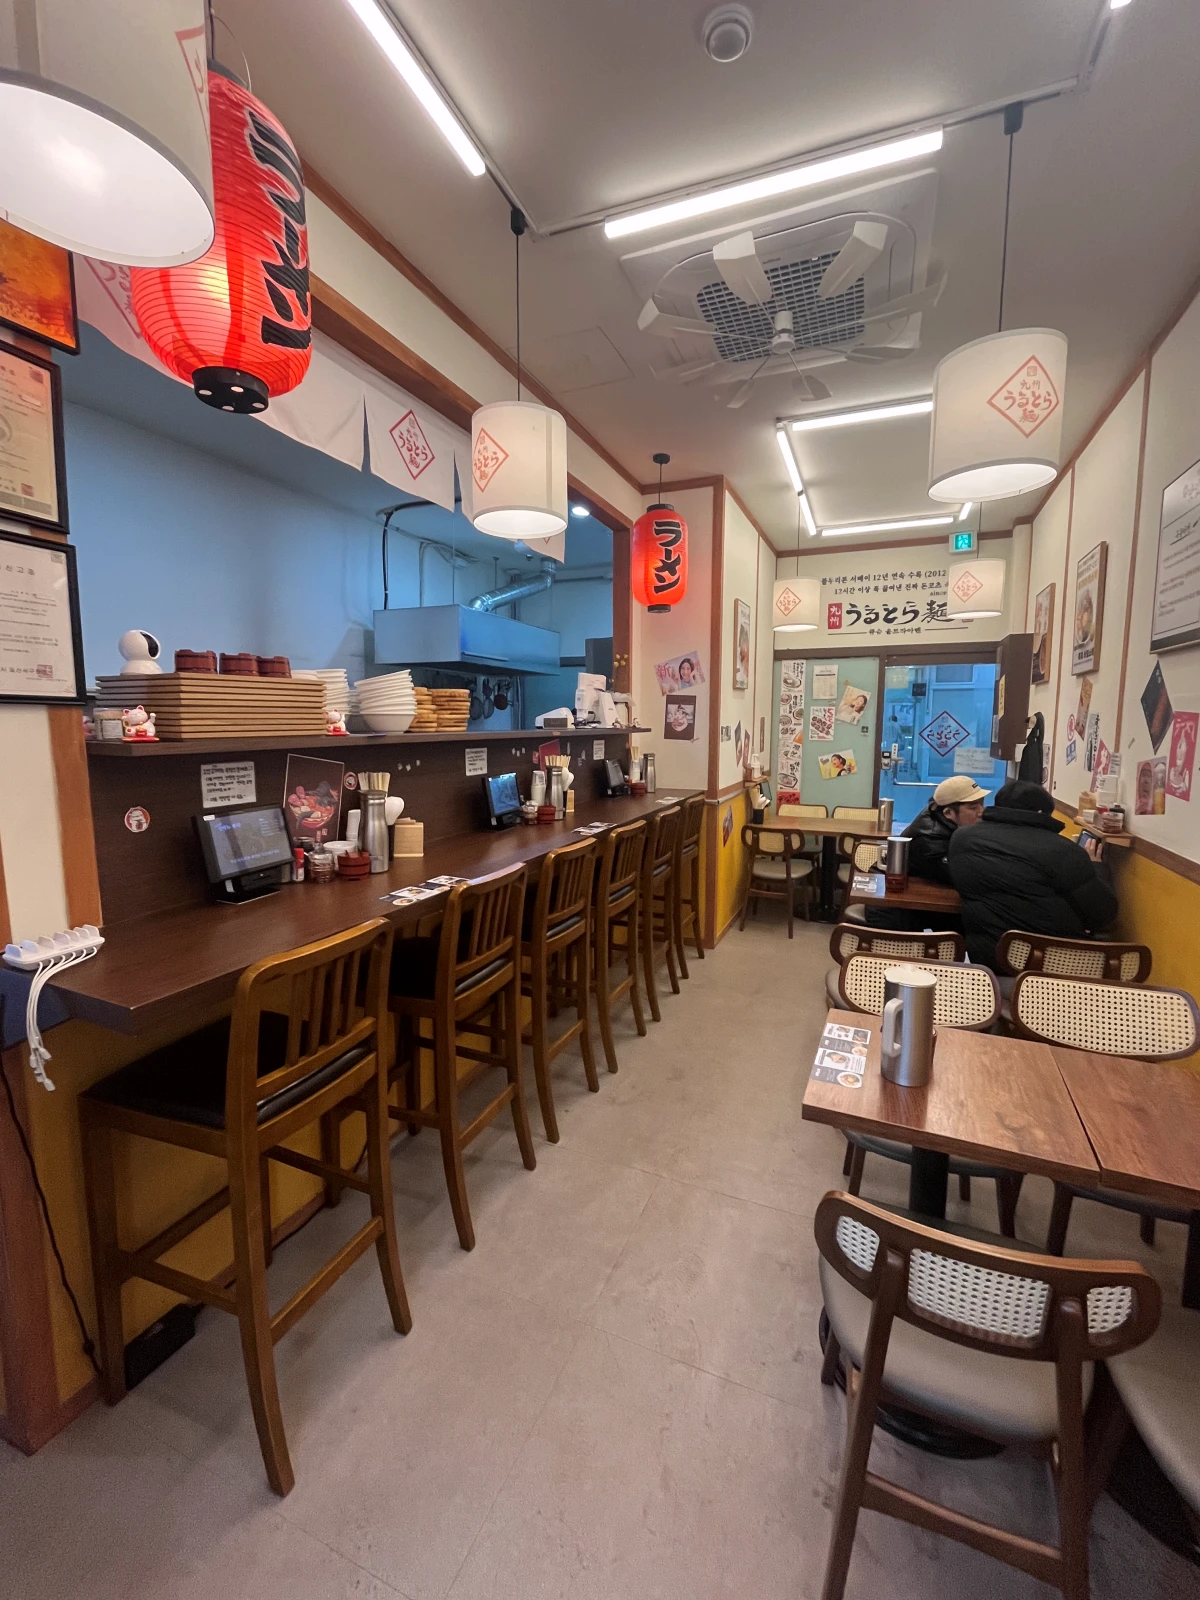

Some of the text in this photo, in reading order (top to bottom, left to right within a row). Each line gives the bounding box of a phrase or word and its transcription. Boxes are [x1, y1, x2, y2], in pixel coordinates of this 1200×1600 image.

[1020, 380, 1040, 390] 九州
[1003, 390, 1052, 411] うるとら
[398, 430, 428, 461] うるとら
[654, 520, 682, 594] ラーメン
[873, 572, 889, 581] 12년
[834, 586, 856, 595] 12시간
[857, 585, 871, 594] 이상
[829, 604, 842, 627] 九州
